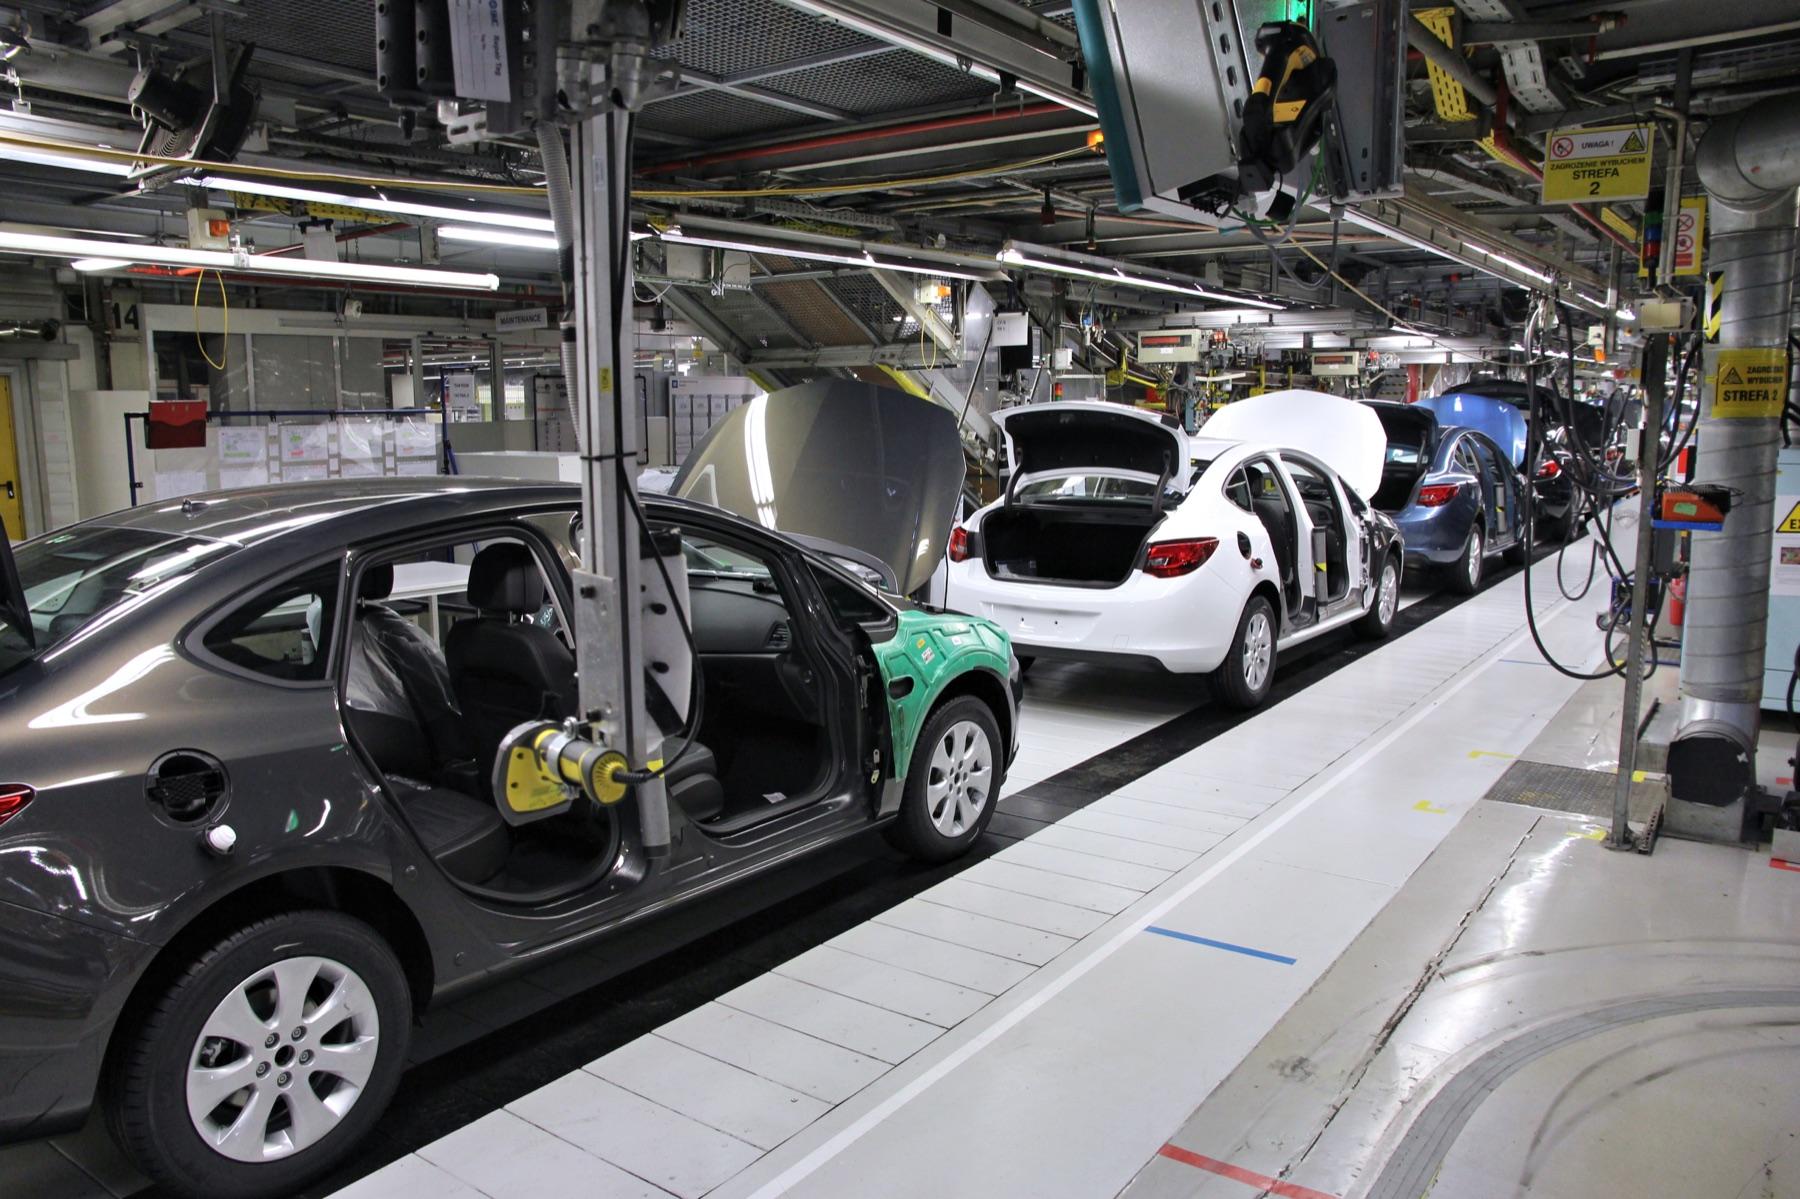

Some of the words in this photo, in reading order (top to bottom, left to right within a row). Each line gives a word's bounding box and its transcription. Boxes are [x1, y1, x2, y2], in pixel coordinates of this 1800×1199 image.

[1581, 141, 1609, 149] UWAGA
[1600, 157, 1646, 167] WYBUCHEM
[1573, 168, 1619, 180] STREFA
[1589, 181, 1600, 195] 2
[112, 302, 140, 330] 14
[499, 313, 542, 325] MAINTENANCE
[1723, 389, 1769, 401] STREFA
[1772, 389, 1778, 401] 2
